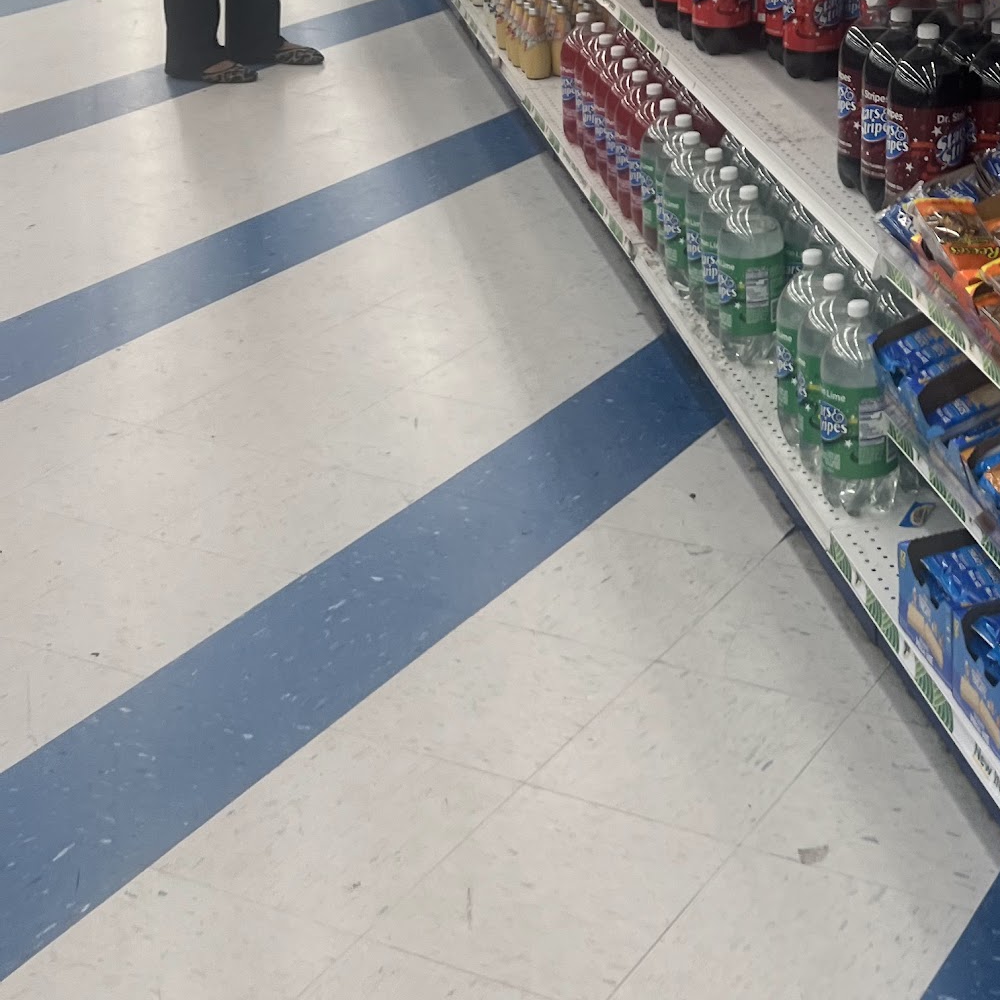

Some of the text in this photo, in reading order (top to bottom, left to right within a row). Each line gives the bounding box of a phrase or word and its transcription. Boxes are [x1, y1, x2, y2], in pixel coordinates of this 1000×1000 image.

[937, 115, 951, 124] Dr.
[826, 390, 846, 402] Lime
[973, 741, 992, 776] New
